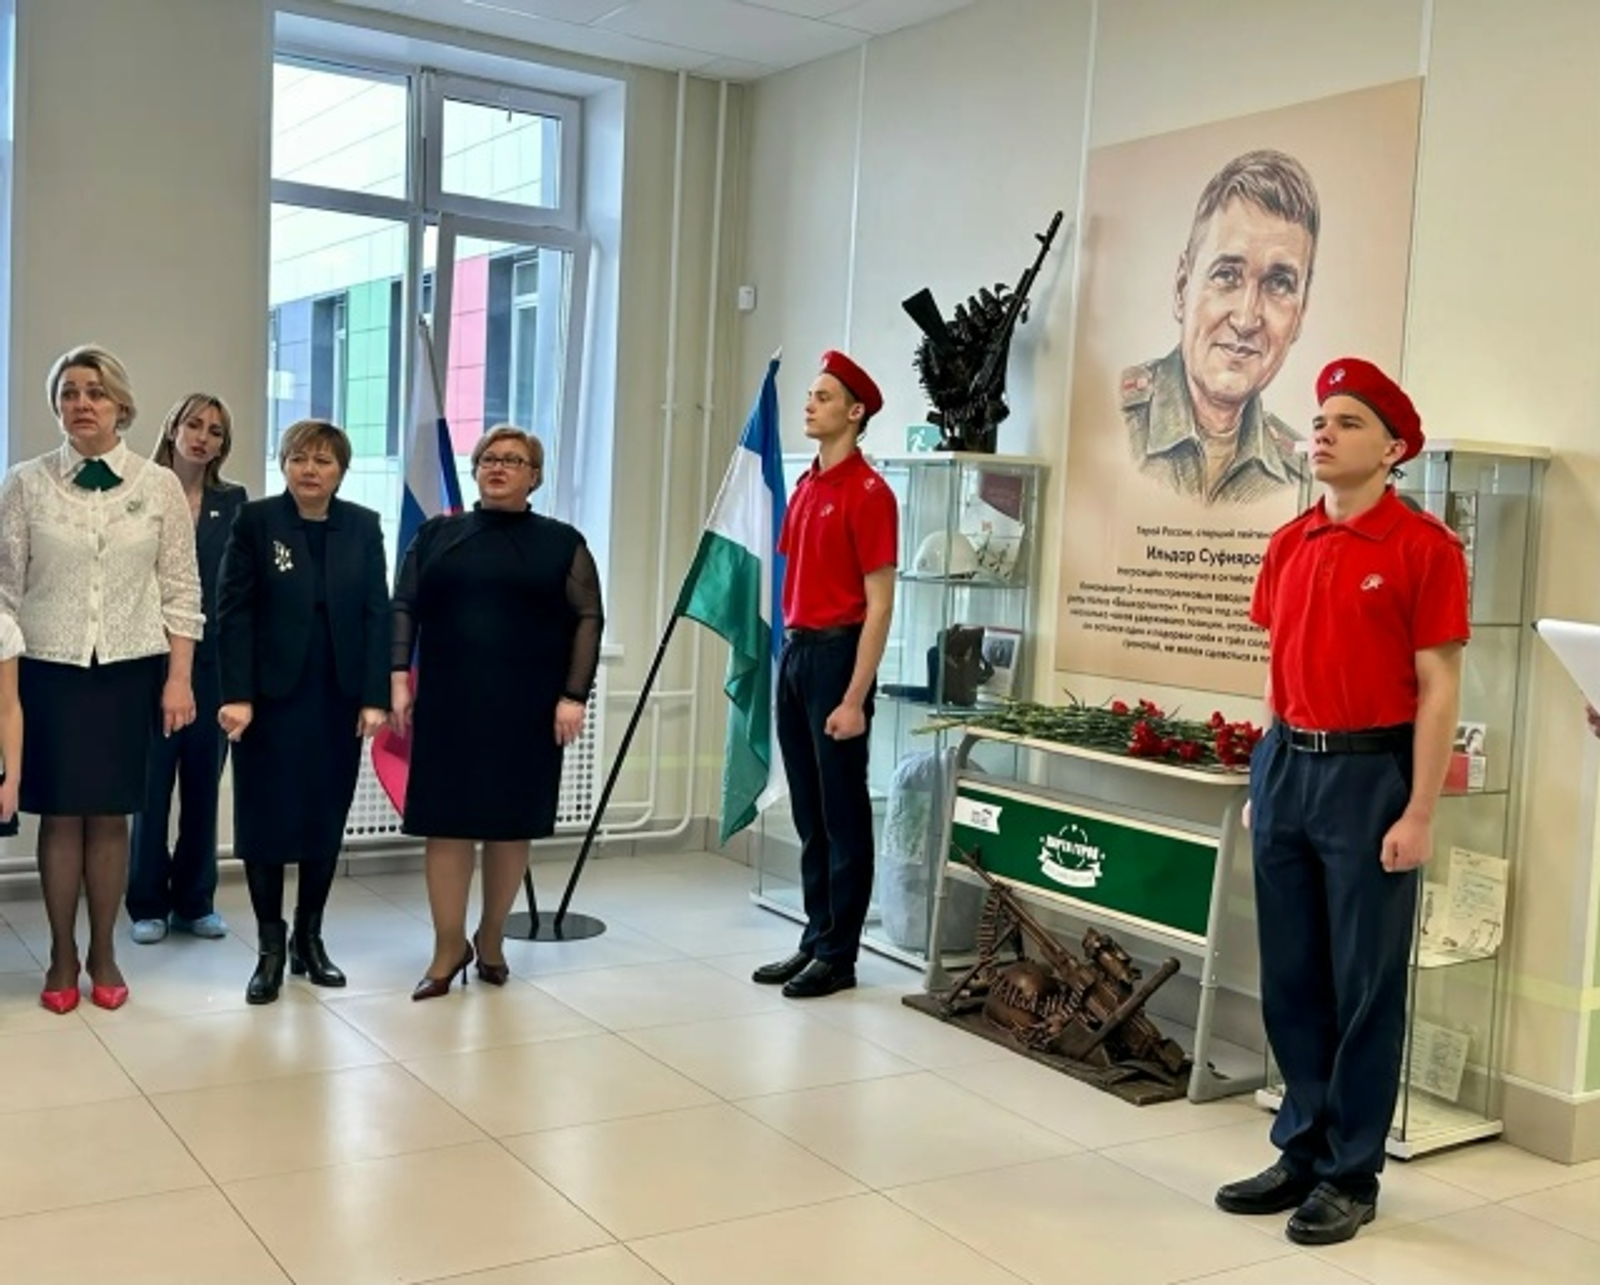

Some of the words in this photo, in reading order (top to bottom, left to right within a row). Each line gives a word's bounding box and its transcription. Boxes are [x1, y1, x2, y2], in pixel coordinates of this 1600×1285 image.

[1146, 545, 1196, 564] Ильдар
[1181, 602, 1213, 615] Группа
[1247, 639, 1270, 650] солд
